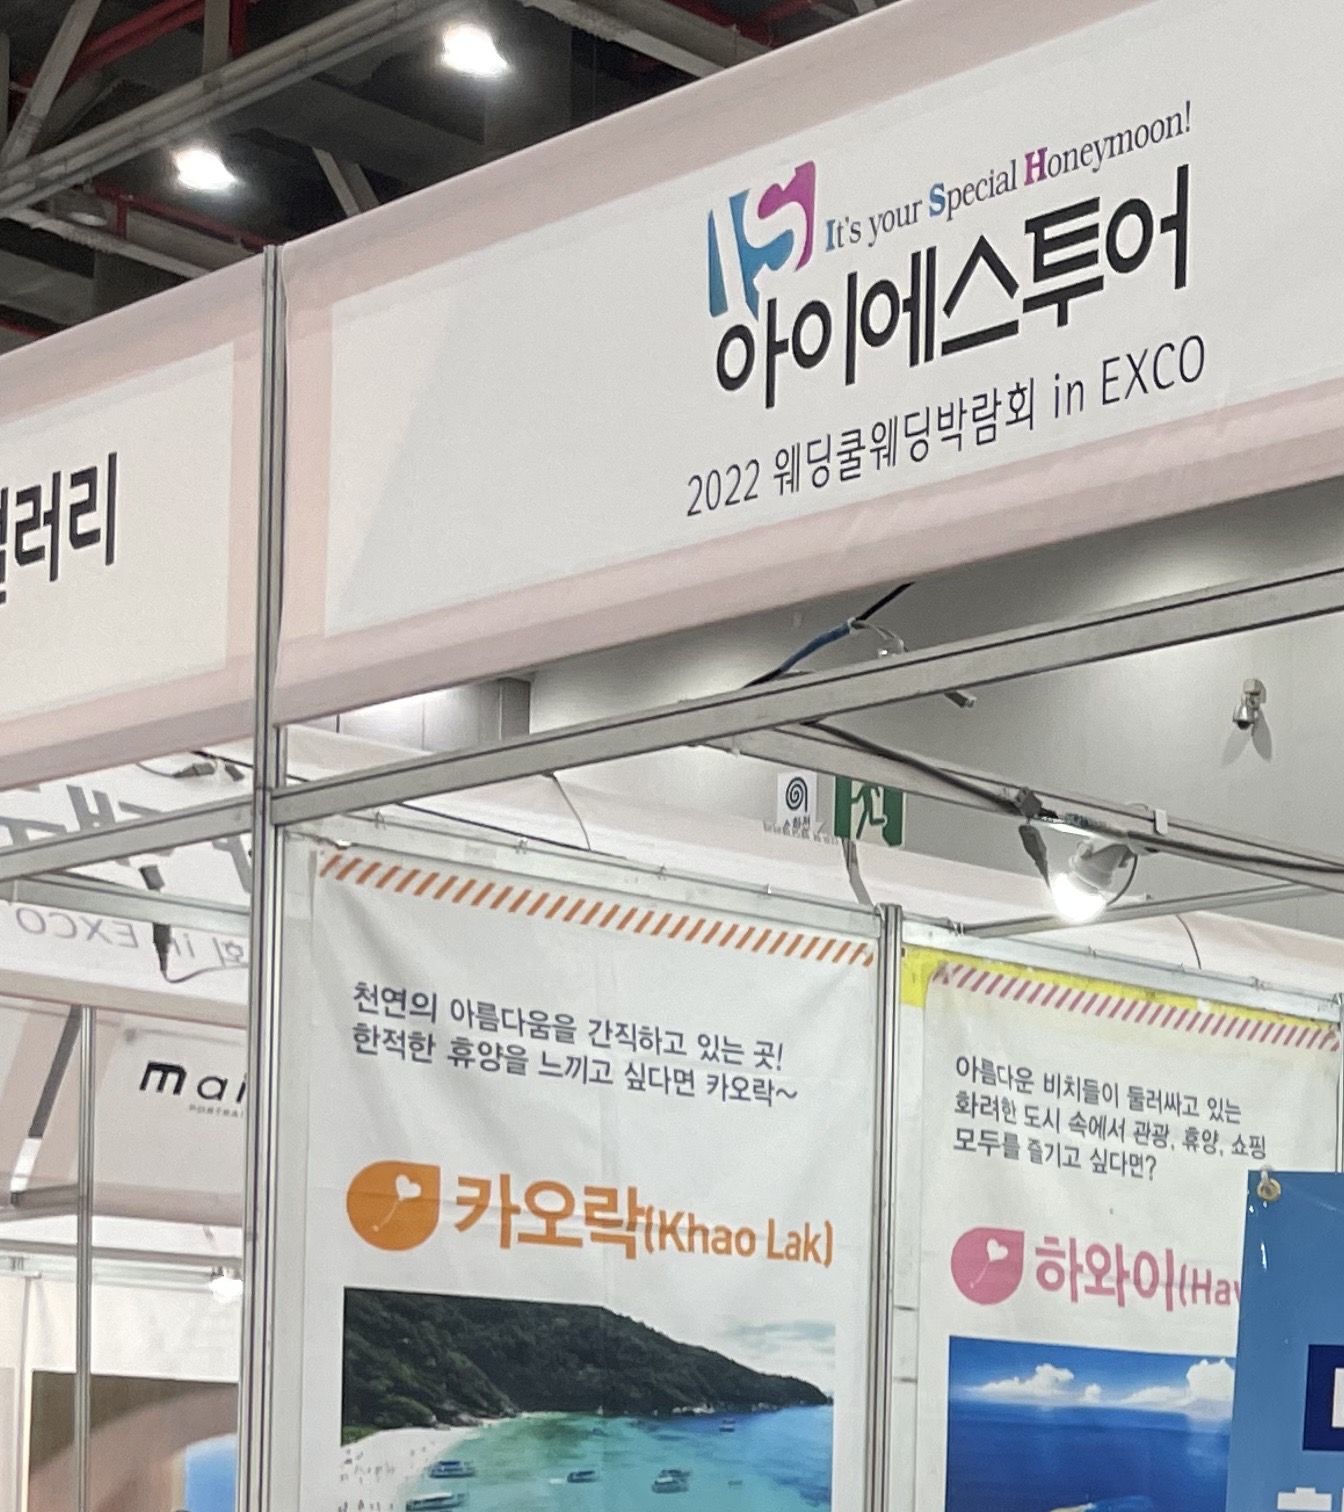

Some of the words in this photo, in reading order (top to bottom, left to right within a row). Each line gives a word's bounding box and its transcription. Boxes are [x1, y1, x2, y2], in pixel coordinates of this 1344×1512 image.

[825, 215, 862, 252] It's
[868, 200, 922, 248] your
[929, 160, 1018, 221] Special
[1024, 101, 1192, 187] Honeymoon!
[716, 164, 1189, 409] 아이에스투어
[687, 460, 761, 517] 2022
[774, 378, 1035, 496] 웨딩쿨웨딩박람회
[1054, 373, 1084, 419] in
[1102, 335, 1205, 406] EXCO
[0, 452, 118, 606] 러리
[352, 1023, 435, 1064] 한적한
[446, 1035, 529, 1078] 휴양을
[538, 1052, 613, 1087] 느끼고
[624, 1061, 696, 1098] 싶다면
[706, 1072, 798, 1108] 카오락~
[353, 982, 437, 1023] 천연의
[448, 997, 577, 1045] 아름다움을
[587, 1018, 687, 1058] 간직하고
[697, 1032, 745, 1068] 있는
[754, 1041, 783, 1073] 곳!
[954, 1090, 1017, 1125] 화려한
[1023, 1104, 1061, 1134] 도시
[1067, 1111, 1127, 1144] 속에서
[1132, 1120, 1175, 1153] 관광,
[1182, 1127, 1224, 1157] 휴양,
[1231, 1133, 1267, 1160] 쇼핑
[955, 1055, 1034, 1096] 아름다운
[1042, 1070, 1120, 1109] 비치들이
[1127, 1084, 1200, 1120] 둘러싸고
[1206, 1098, 1242, 1126] 있는
[953, 1127, 1020, 1162] 모두를
[1027, 1138, 1082, 1171] 즐기고
[1090, 1149, 1158, 1183] 싶다면?
[767, 1220, 834, 1269] Lak)
